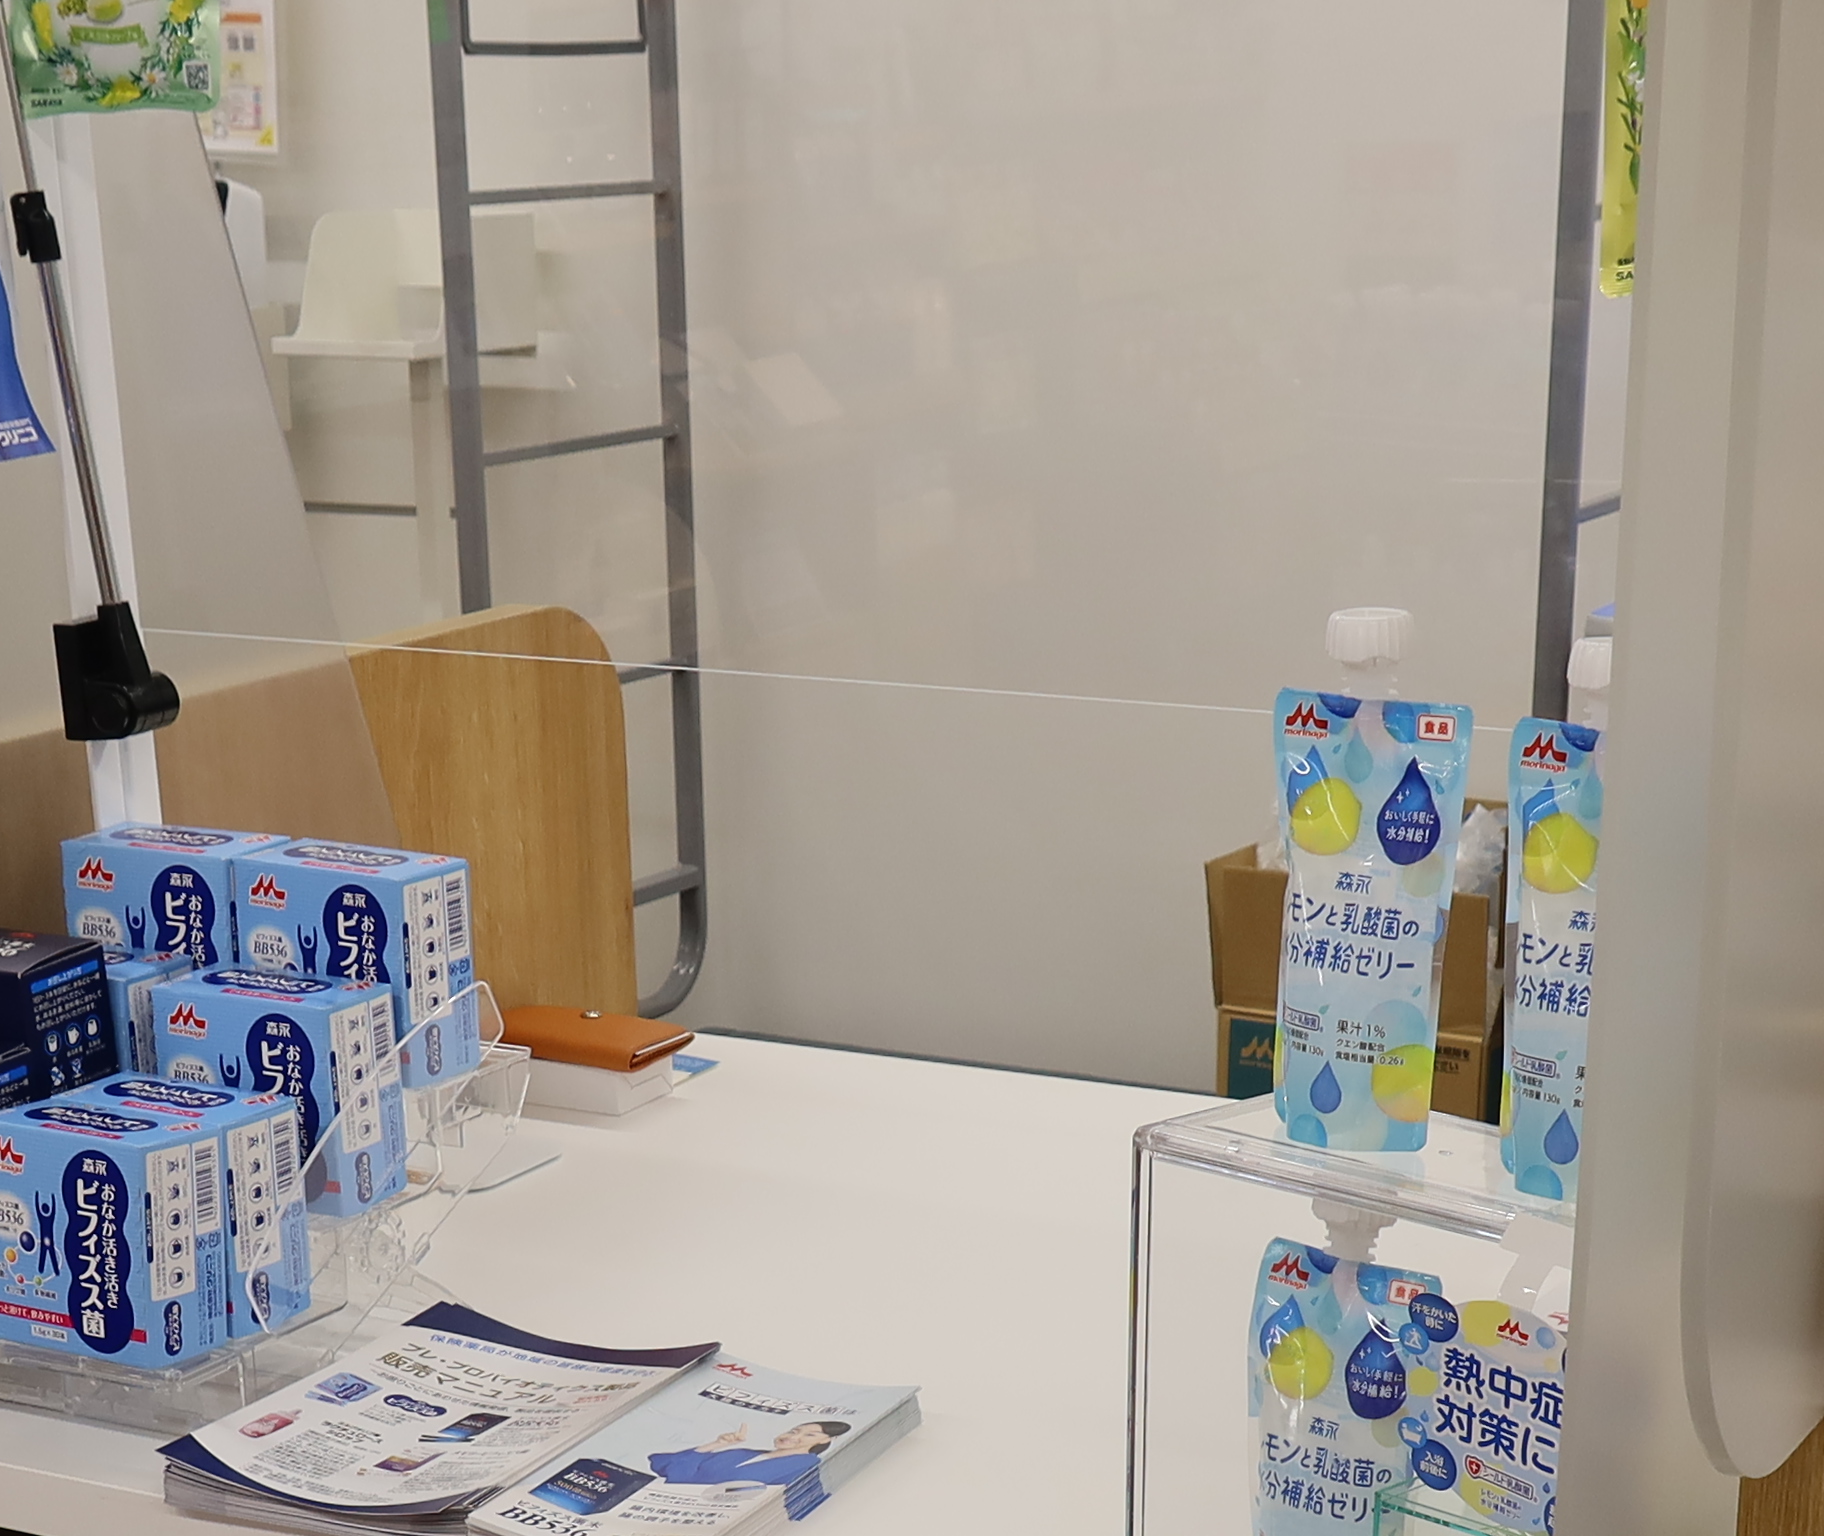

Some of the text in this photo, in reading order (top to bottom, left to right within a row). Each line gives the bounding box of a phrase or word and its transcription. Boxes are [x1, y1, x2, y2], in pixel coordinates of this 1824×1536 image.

[170, 872, 193, 889] 森永
[1335, 873, 1373, 894] 森永
[343, 892, 366, 908] 森永
[1287, 895, 1419, 940] モンと乳酸菌の
[266, 1021, 291, 1038] 森永
[82, 1158, 107, 1176] 森永
[101, 1184, 119, 1309] おなか活き活き
[77, 1178, 106, 1338] ビフィズス菌
[1309, 1418, 1340, 1440] 森永
[1435, 1394, 1555, 1474] 対策に
